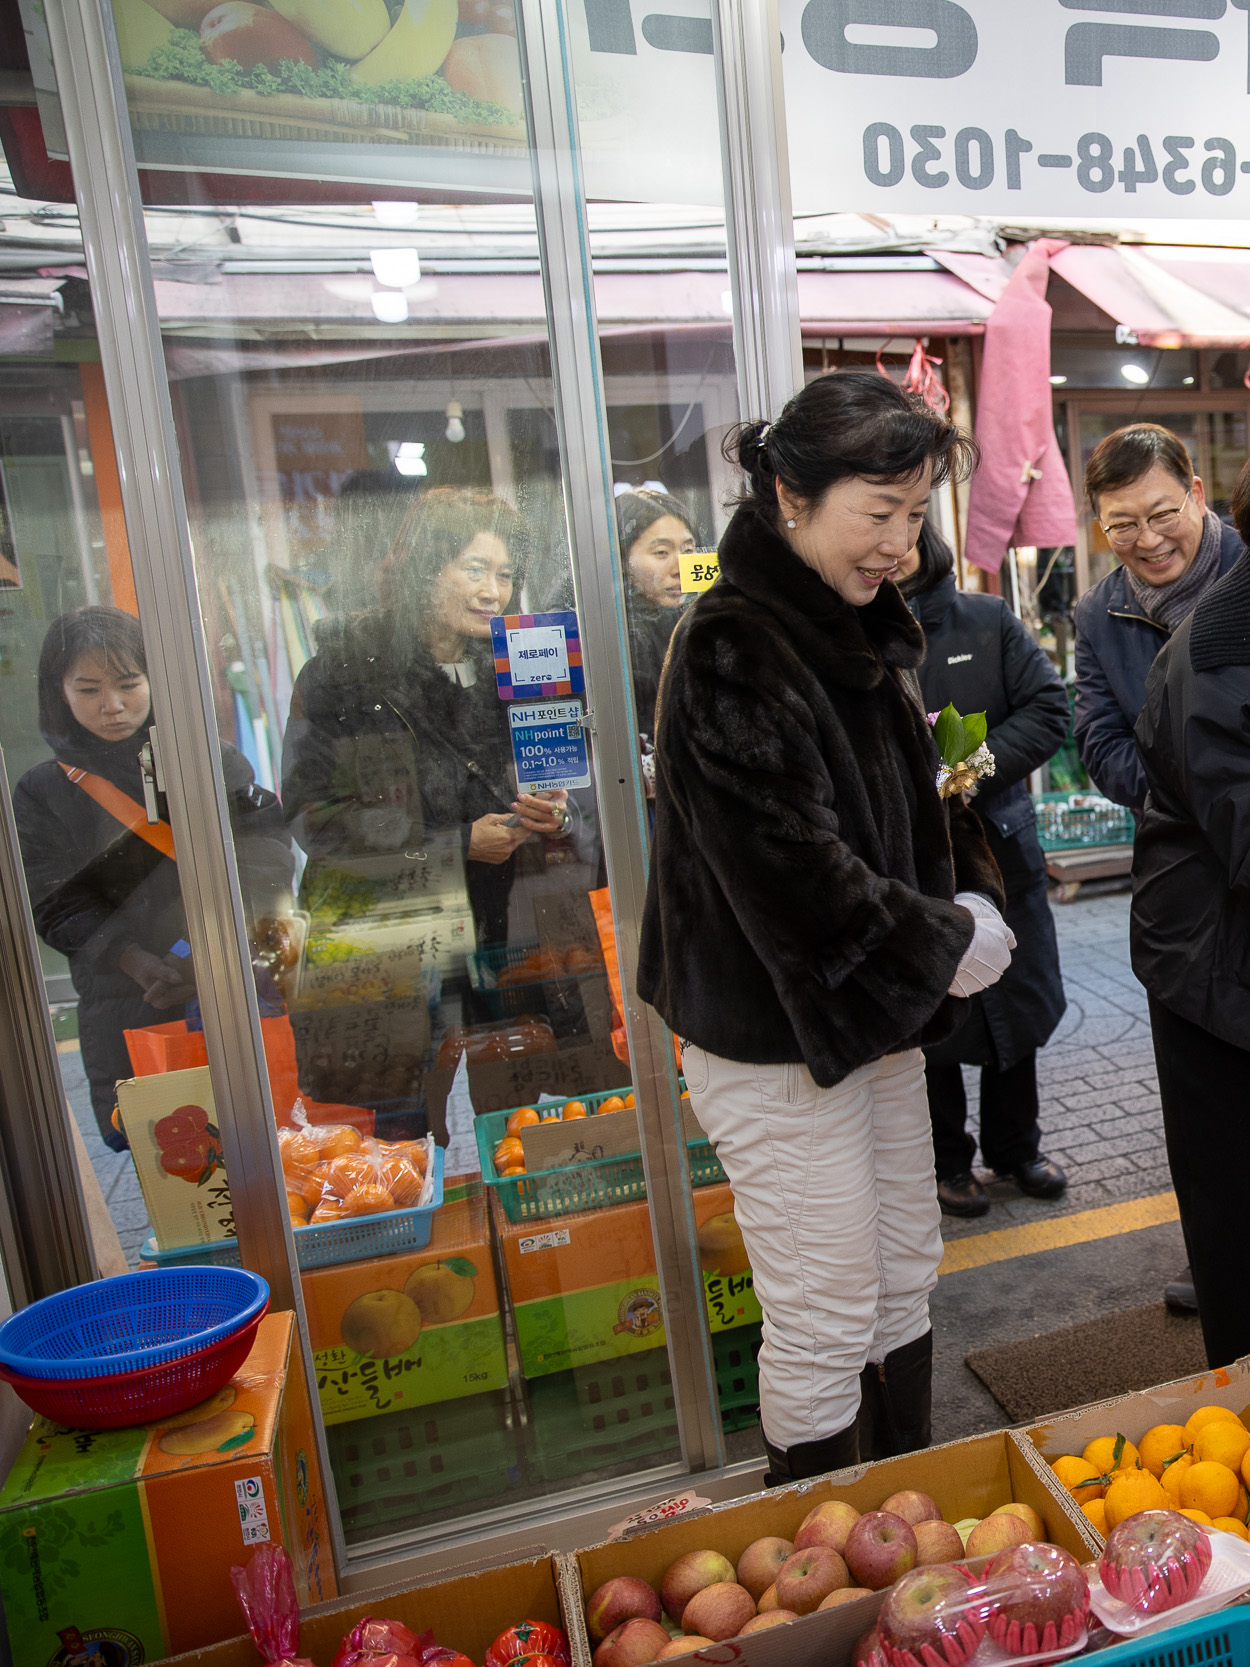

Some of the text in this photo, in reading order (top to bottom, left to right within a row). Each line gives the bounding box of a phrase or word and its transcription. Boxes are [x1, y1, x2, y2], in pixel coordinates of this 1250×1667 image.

[518, 647, 558, 660] 제로페이
[530, 674, 553, 682] zero
[512, 706, 580, 722] NH 포인트 샵
[520, 745, 578, 757] 100% 사용가능
[704, 1276, 753, 1325] 들배
[462, 1370, 489, 1384] 15kg
